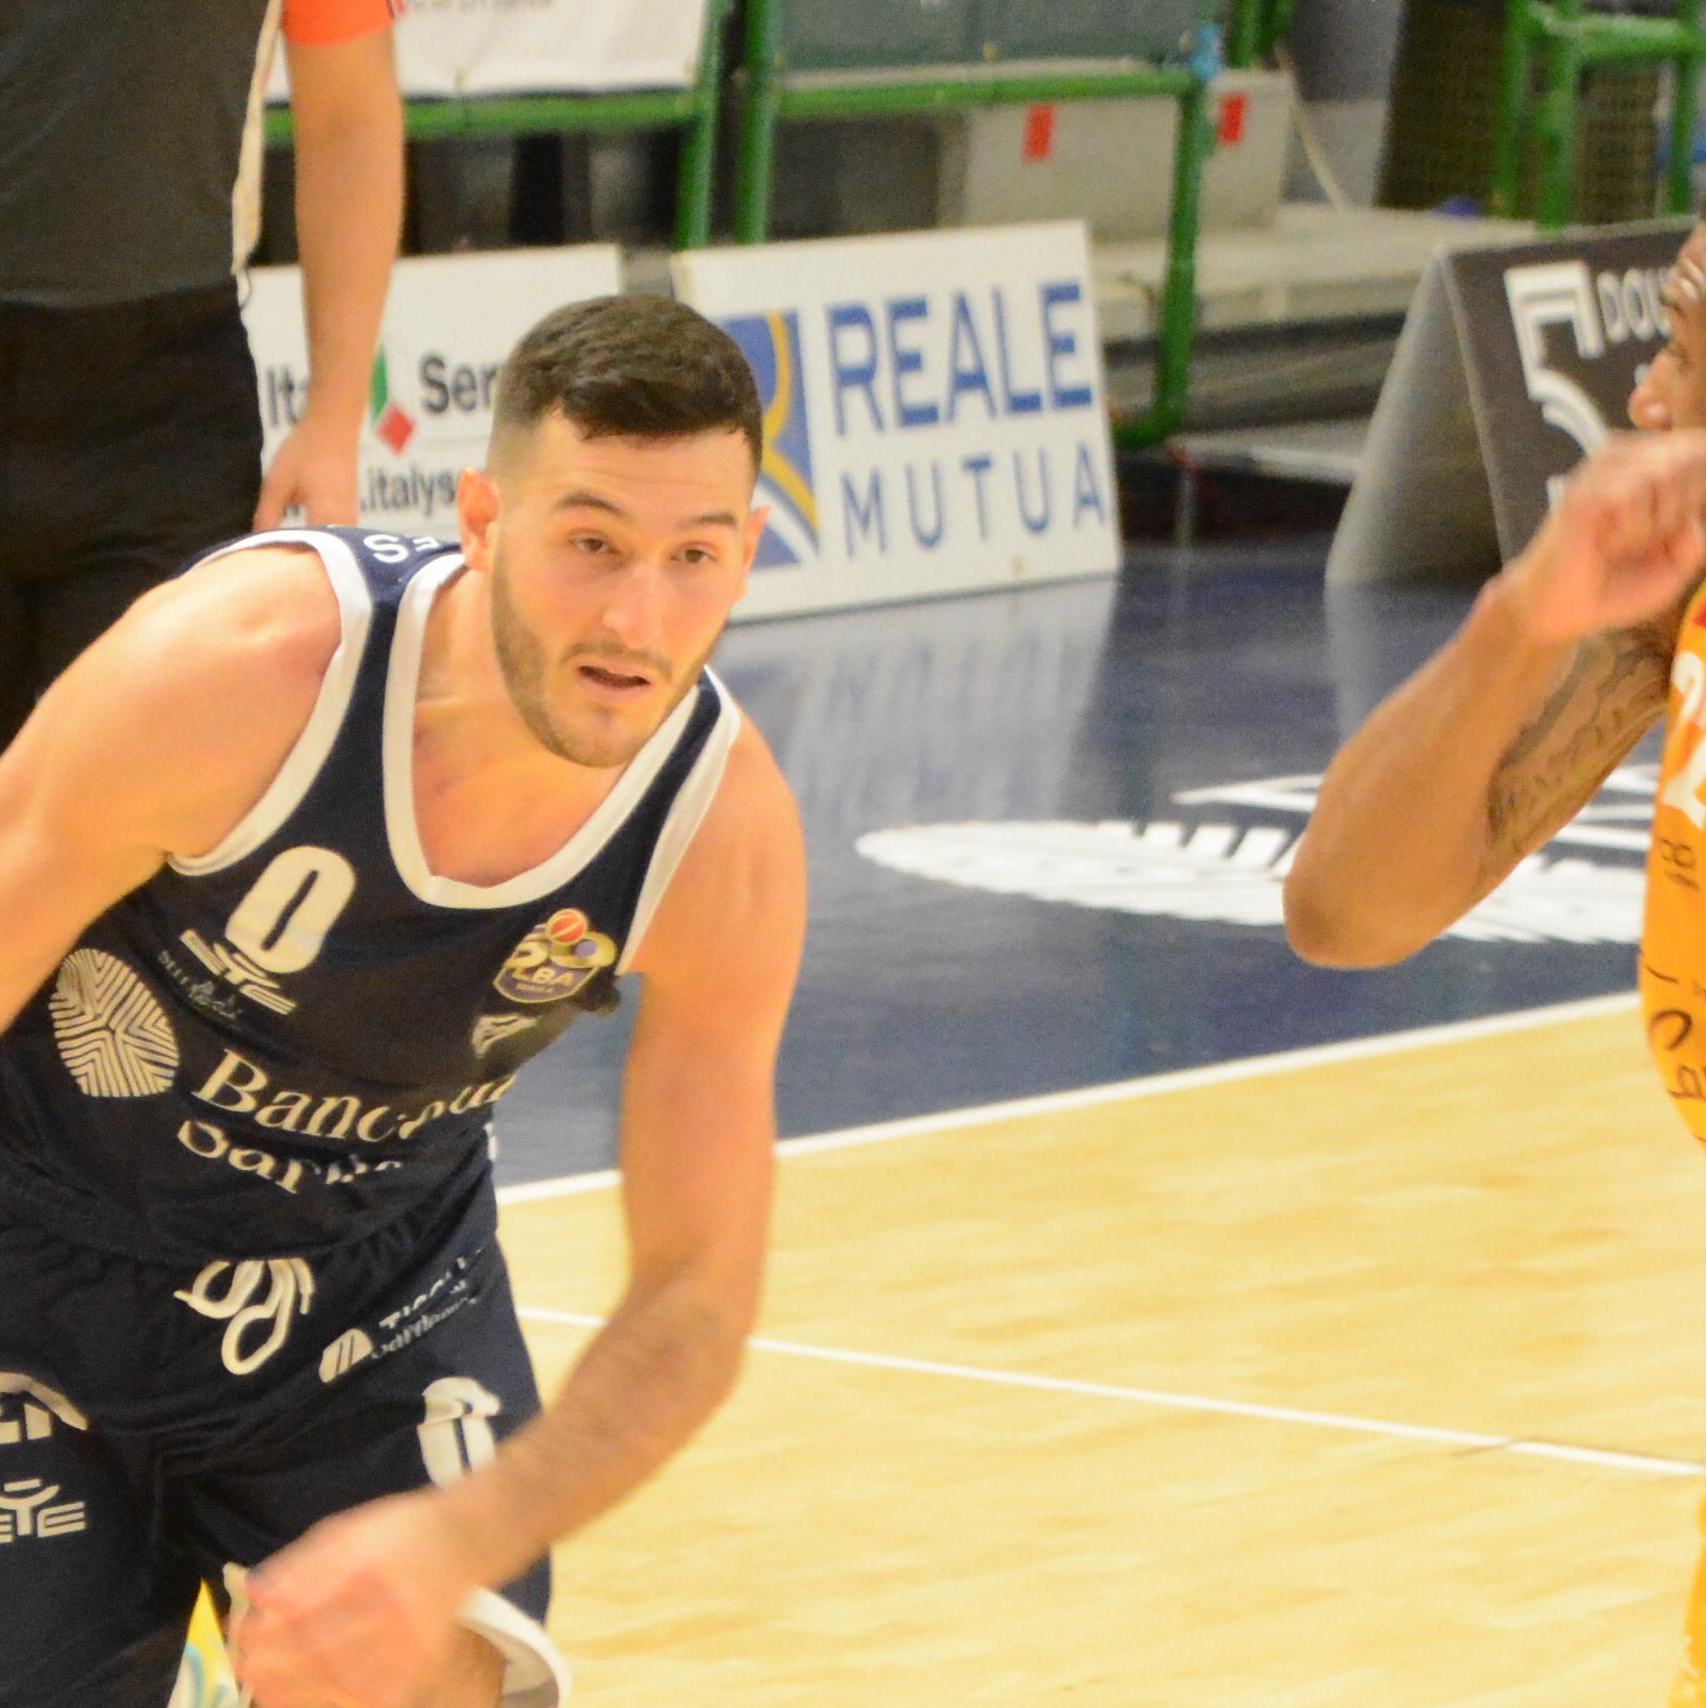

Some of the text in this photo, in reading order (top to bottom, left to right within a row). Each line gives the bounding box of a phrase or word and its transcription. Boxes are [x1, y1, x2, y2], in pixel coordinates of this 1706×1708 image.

[824, 279, 1094, 438] REALE
[839, 441, 1108, 561] MUTUA
[225, 844, 357, 974] 0
